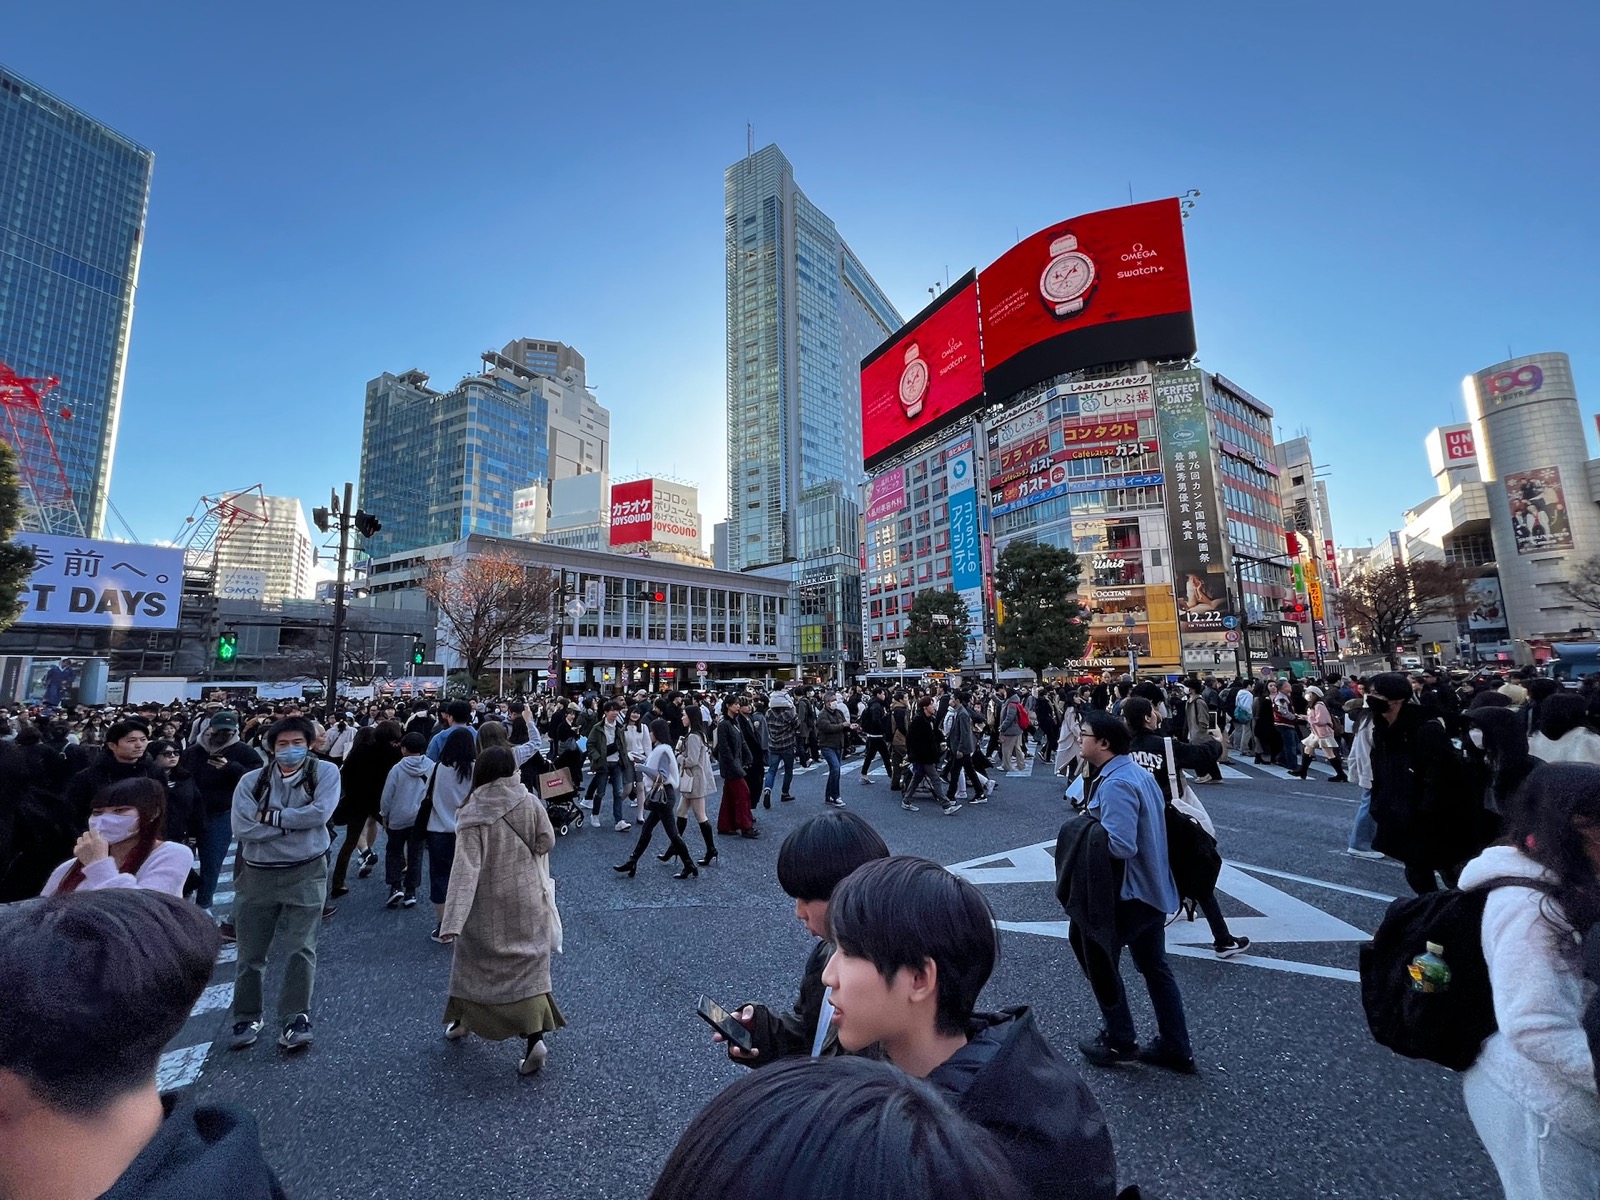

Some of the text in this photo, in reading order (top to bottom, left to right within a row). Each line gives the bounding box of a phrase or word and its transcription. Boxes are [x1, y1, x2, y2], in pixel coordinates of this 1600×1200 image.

[1121, 250, 1157, 262] OMEGA
[941, 341, 963, 359] OMEGA
[1070, 375, 1148, 392] しゃぶしゃぶバイキング
[1483, 365, 1544, 397] 109
[1103, 389, 1150, 407] しゃぶ葉
[1157, 383, 1200, 397] PERFECT
[1166, 393, 1193, 404] DAYS
[991, 396, 1043, 426] しゃぶしゃぶバイキング
[1014, 409, 1045, 433] しゃぶ葉
[988, 434, 998, 446] 9F
[1064, 423, 1136, 441] コンタクト
[1115, 443, 1150, 457] ガスト
[1030, 458, 1054, 475] ガスト
[1018, 477, 1048, 498] ガスト
[1099, 476, 1162, 488] 英会話イーオン
[1175, 452, 1190, 513] 最優秀男優賞
[654, 489, 688, 506] ココロの
[992, 492, 1003, 503] 7F
[612, 498, 651, 516] カラオケ
[1188, 451, 1210, 562] 第76回カンヌ国際映画祭
[611, 512, 652, 527] JOYSOUND
[652, 520, 697, 538] JOYSOUND
[964, 501, 977, 572] コンタクトの
[1182, 520, 1193, 540] 受賞
[952, 504, 966, 574] アイシティ
[796, 574, 838, 586] MARK CITY
[224, 586, 259, 594] GMO
[69, 586, 167, 617] DAYS
[1186, 611, 1222, 623] 12.22
[1281, 624, 1298, 638] LUSH
